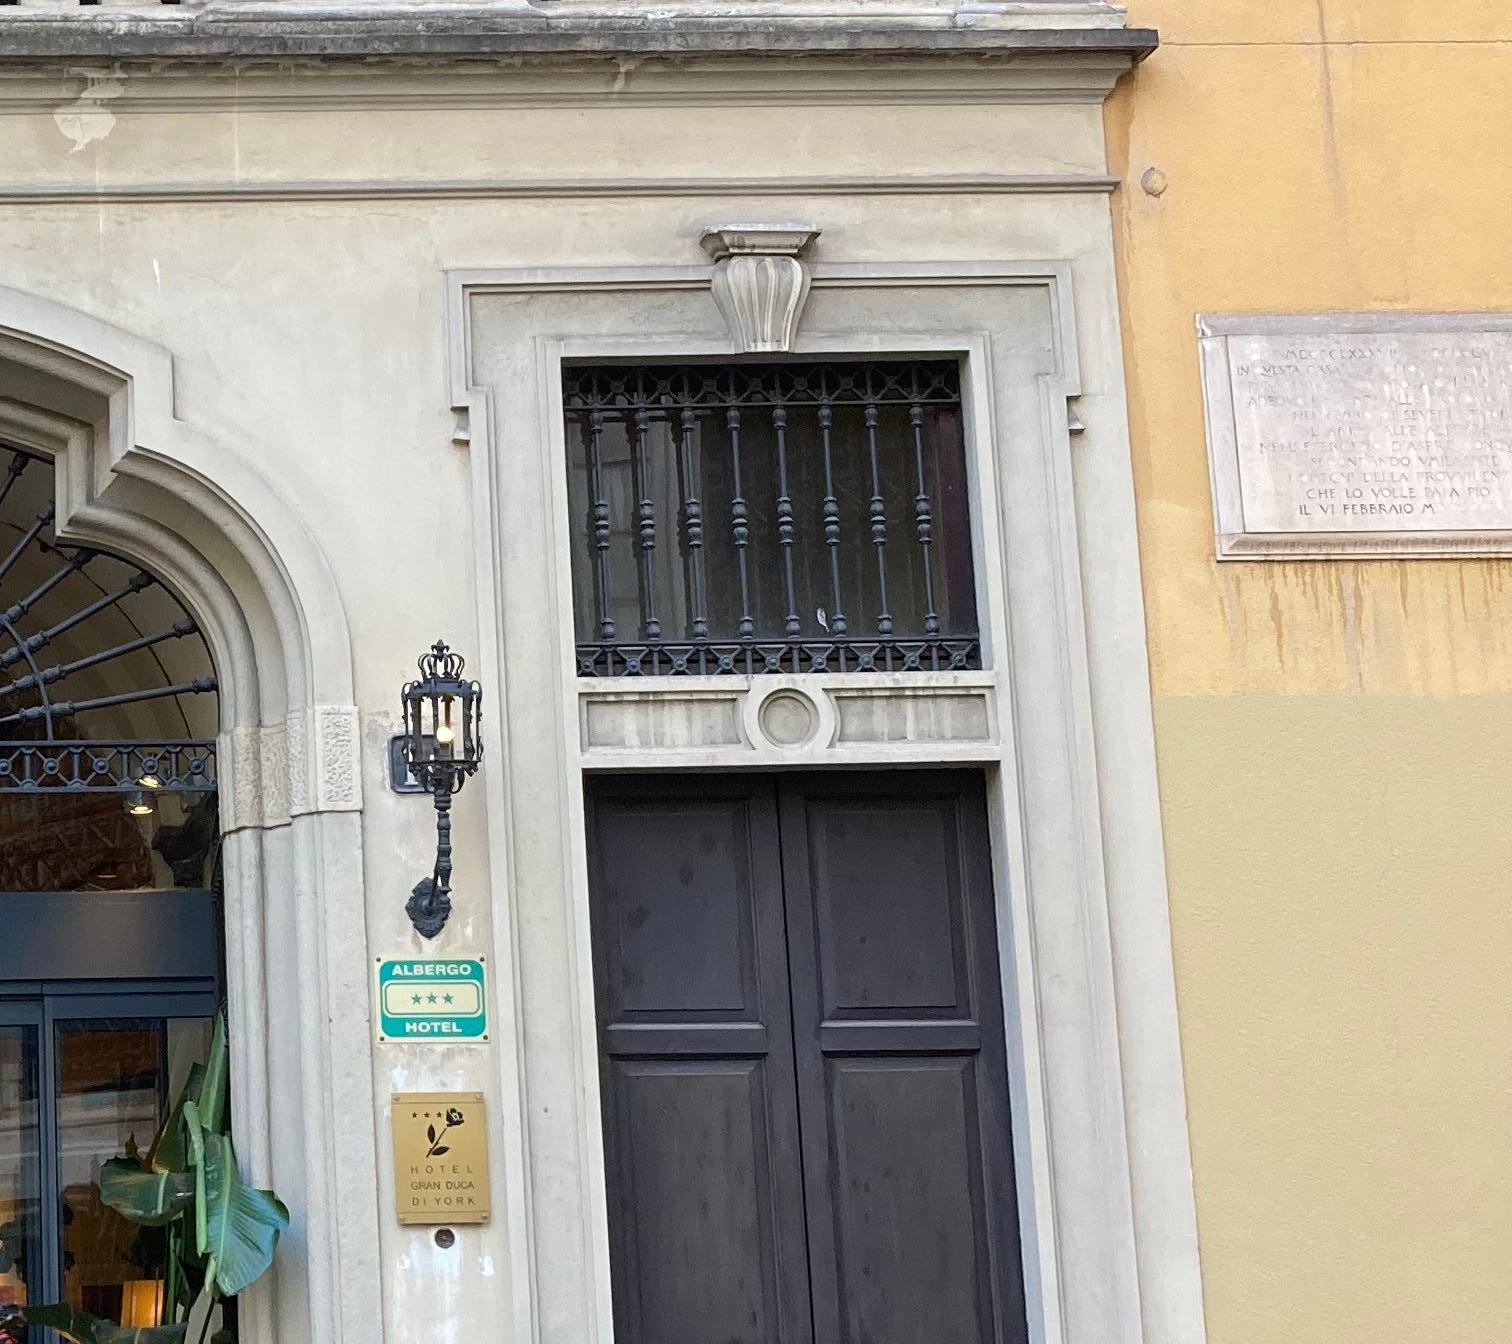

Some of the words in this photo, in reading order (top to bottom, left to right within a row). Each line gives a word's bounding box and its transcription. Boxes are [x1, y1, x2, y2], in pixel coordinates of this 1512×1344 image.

[1306, 488, 1337, 500] CHE
[1345, 488, 1364, 499] LO
[1370, 487, 1417, 499] VOLLE
[1299, 504, 1313, 516] IL
[1319, 503, 1336, 515] VI
[1343, 503, 1414, 515] FEBBRAIO
[391, 963, 473, 977] ALBERGO
[404, 1021, 463, 1034] HOTEL
[410, 1164, 473, 1174] HOTEL
[410, 1180, 441, 1191] GRAN
[445, 1180, 474, 1190] DUCA
[412, 1196, 427, 1206] DI
[434, 1196, 476, 1206] YORK
